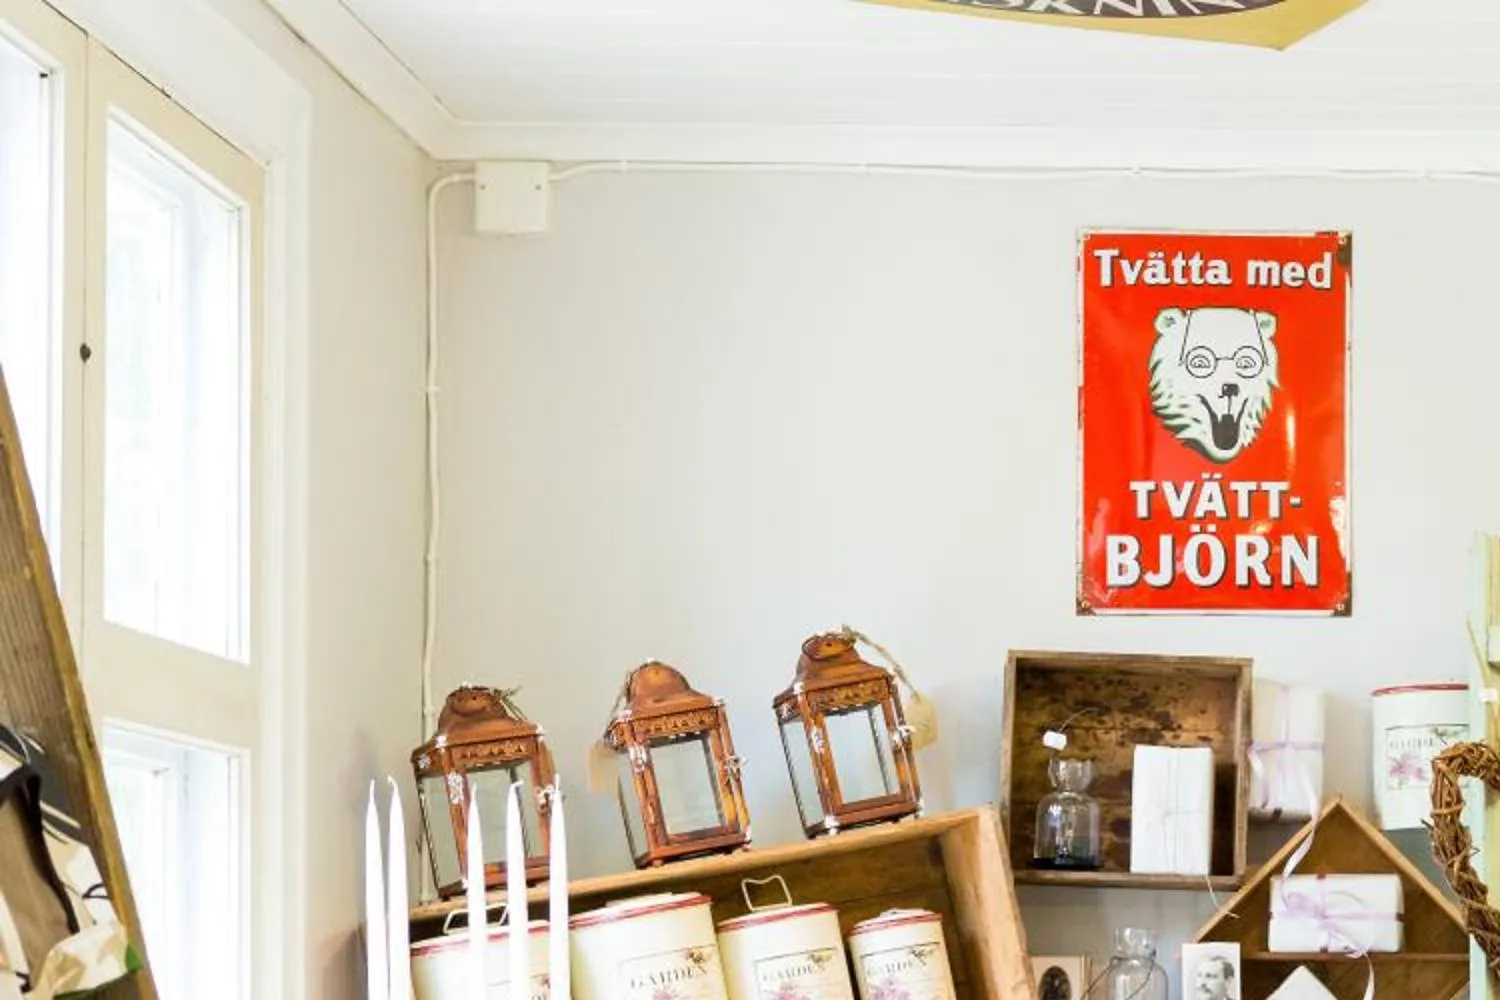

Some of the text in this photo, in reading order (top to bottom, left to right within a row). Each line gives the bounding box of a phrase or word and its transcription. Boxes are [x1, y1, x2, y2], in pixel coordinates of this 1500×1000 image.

[1094, 249, 1333, 290] Tvätta med
[1129, 471, 1303, 520] TVÄTT-
[1105, 523, 1321, 590] BJÖRN
